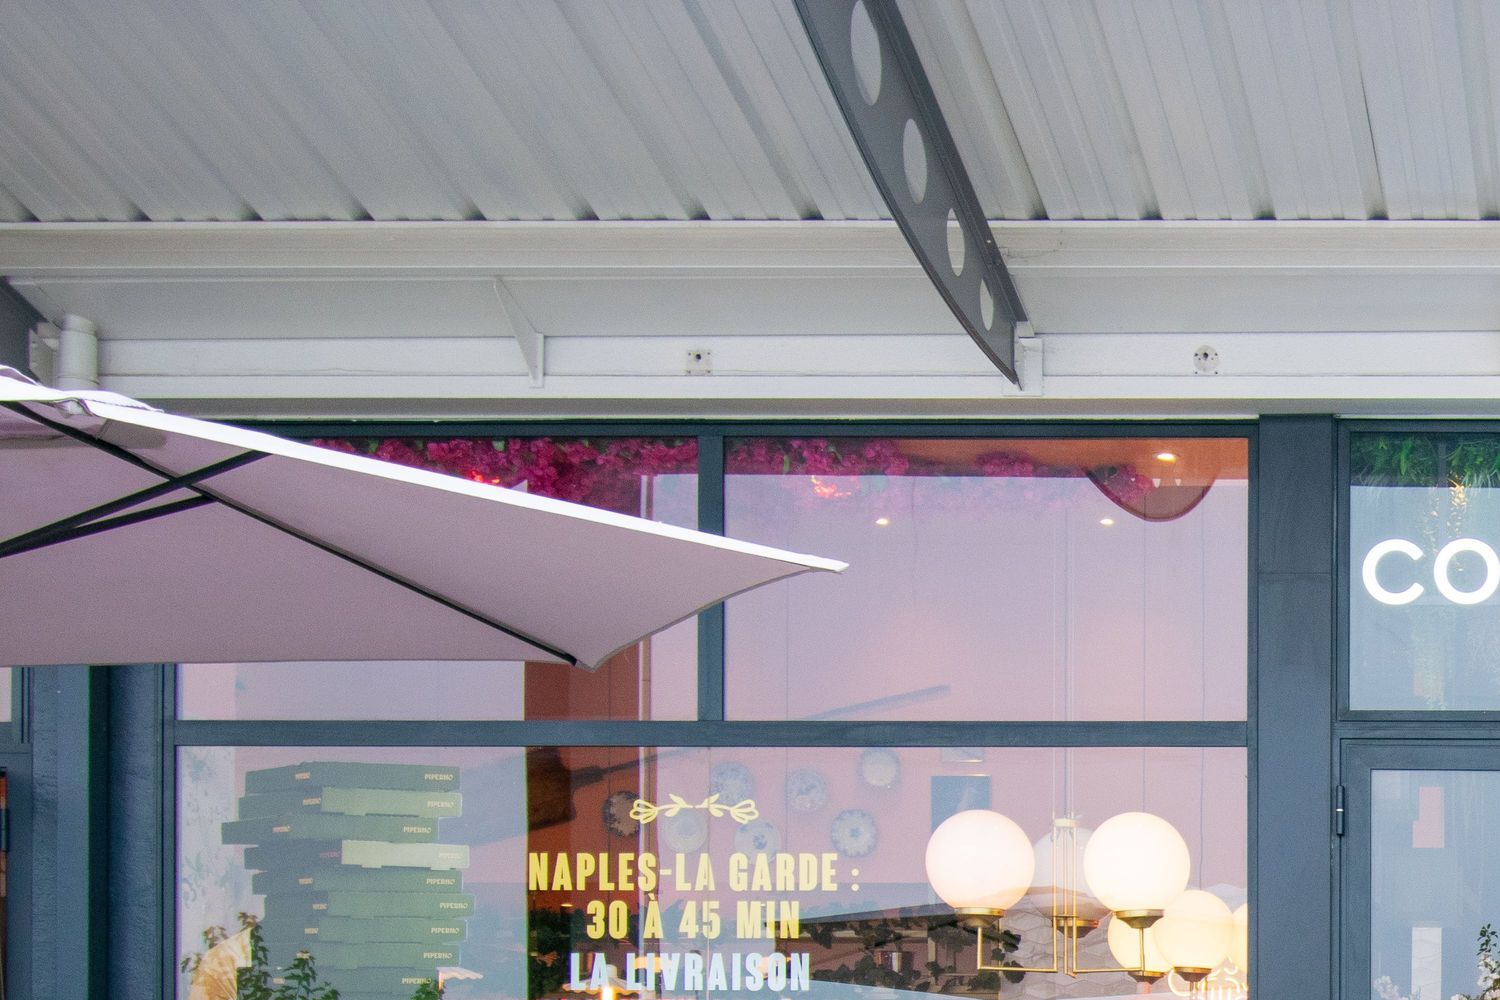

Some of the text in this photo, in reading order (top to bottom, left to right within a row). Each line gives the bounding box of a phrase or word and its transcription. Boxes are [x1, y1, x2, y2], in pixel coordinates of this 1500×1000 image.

[528, 852, 716, 891] NAPLES-LA
[728, 852, 838, 891] GARDE
[586, 893, 799, 939] 30 À 45 MIN
[570, 952, 810, 992] LA LIVRAISON
